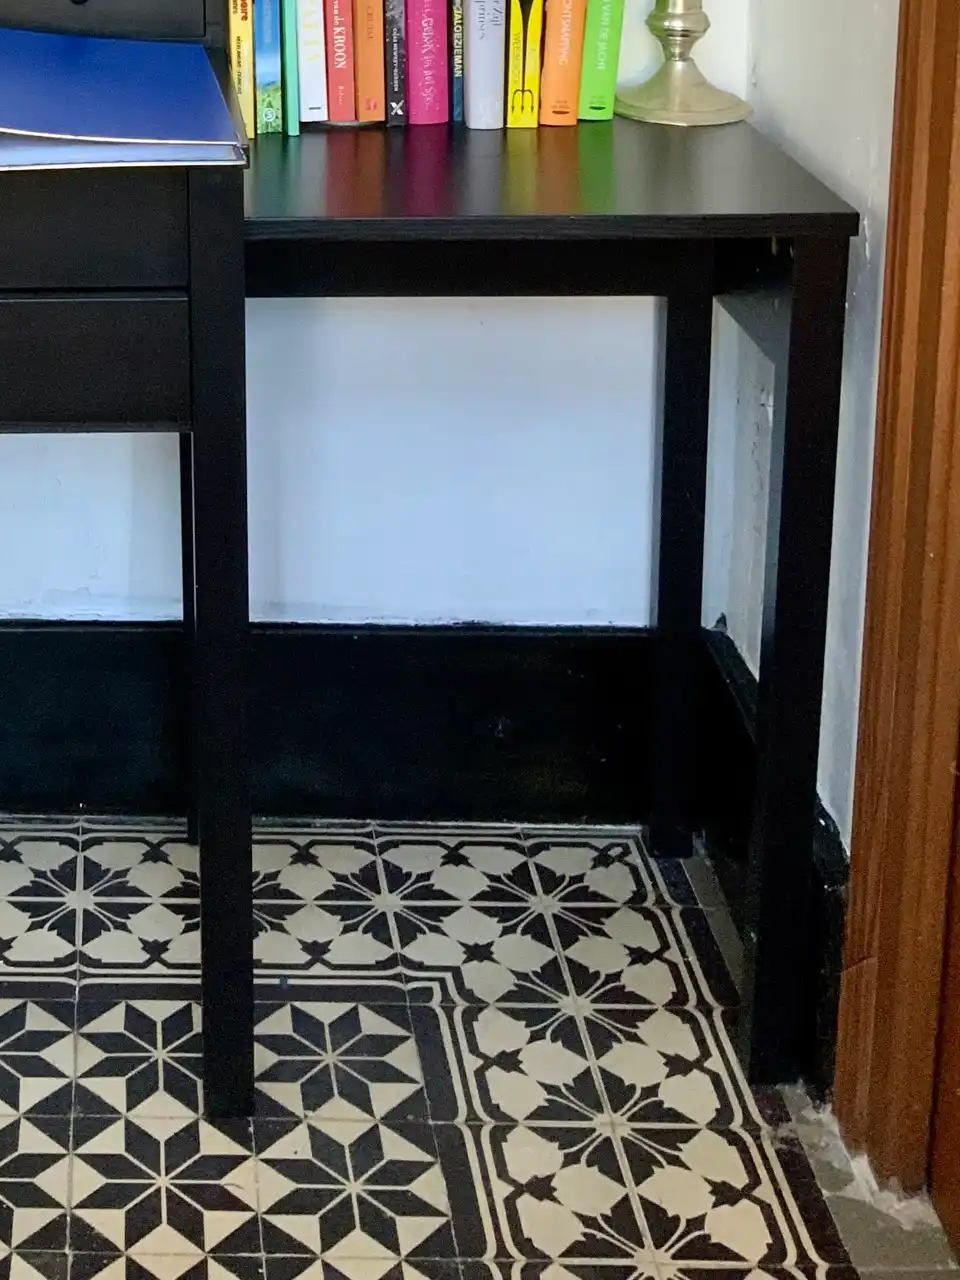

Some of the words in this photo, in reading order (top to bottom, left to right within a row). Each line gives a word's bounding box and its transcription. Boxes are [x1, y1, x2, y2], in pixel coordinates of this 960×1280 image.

[333, 1, 342, 15] van
[489, 7, 503, 27] Zijl
[600, 5, 611, 26] VAN
[333, 15, 344, 26] de
[474, 0, 489, 41] prinses
[599, 28, 609, 39] DE
[332, 26, 346, 69] KROON
[596, 41, 608, 70] JACHT
